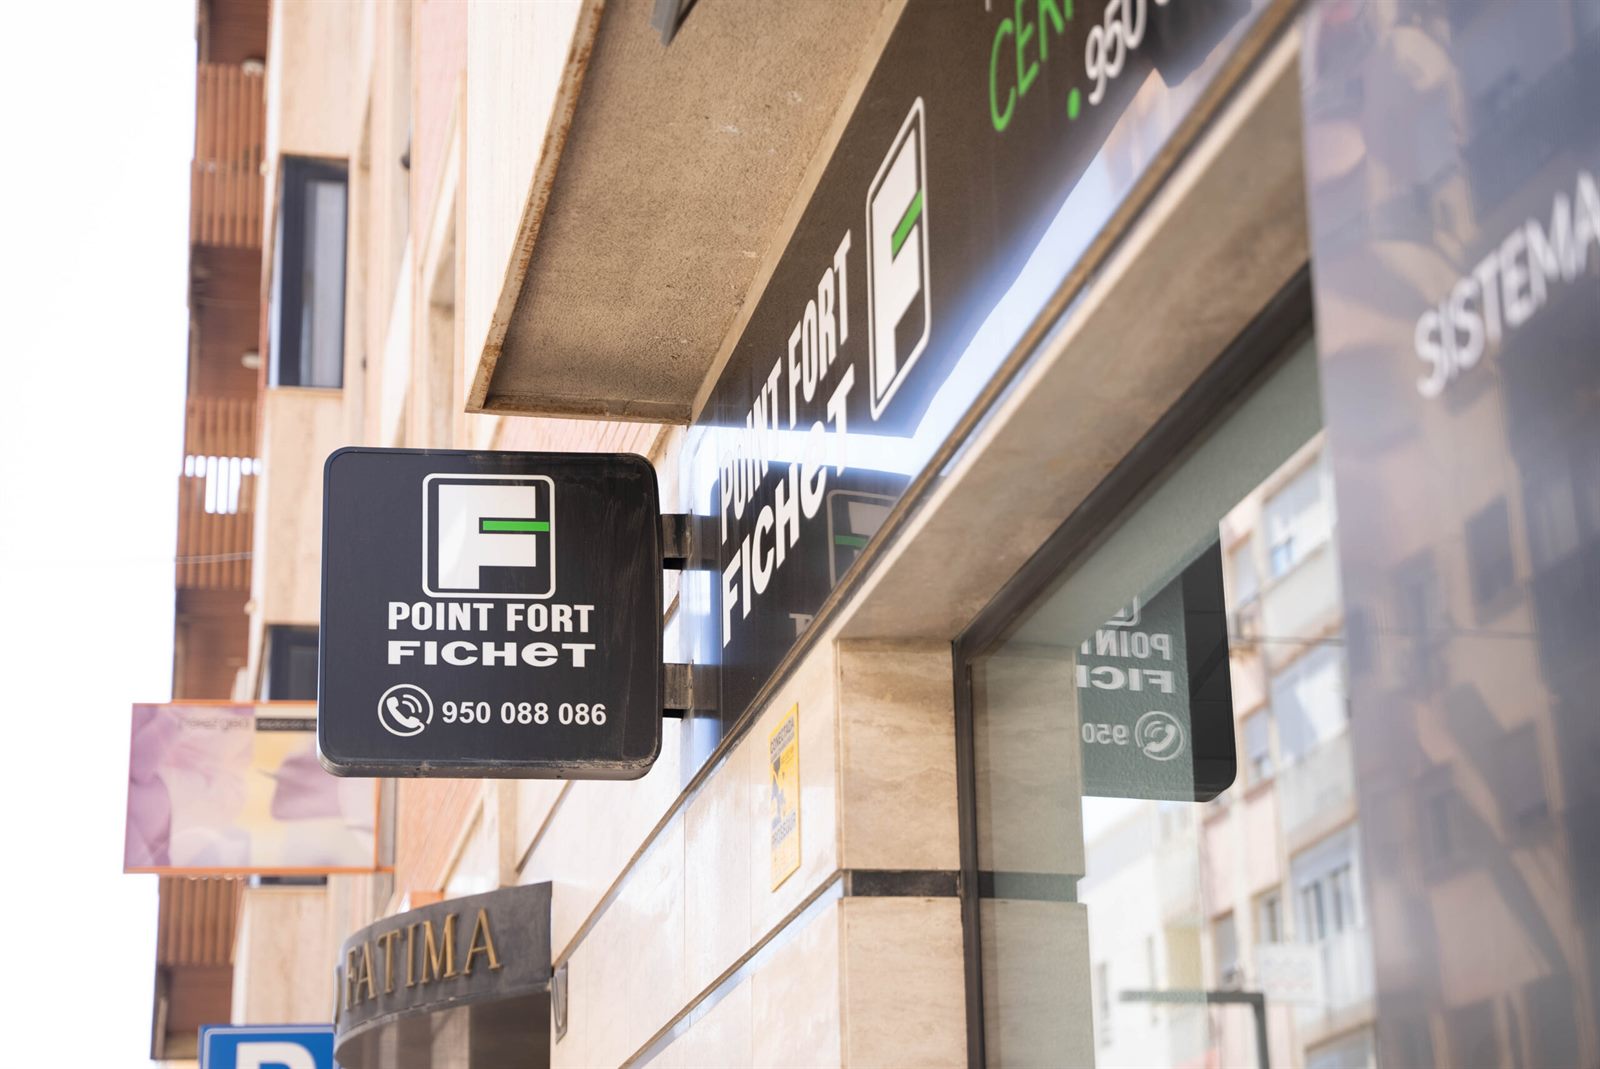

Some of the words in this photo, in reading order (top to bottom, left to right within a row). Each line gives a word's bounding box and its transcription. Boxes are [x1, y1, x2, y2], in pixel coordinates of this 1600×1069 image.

[788, 228, 852, 428] FORT
[387, 601, 495, 632] POINT
[506, 603, 595, 633] FORT
[441, 701, 491, 725] 950
[500, 702, 550, 726] 088
[557, 703, 607, 726] 086
[344, 907, 502, 1011] FATIMA
